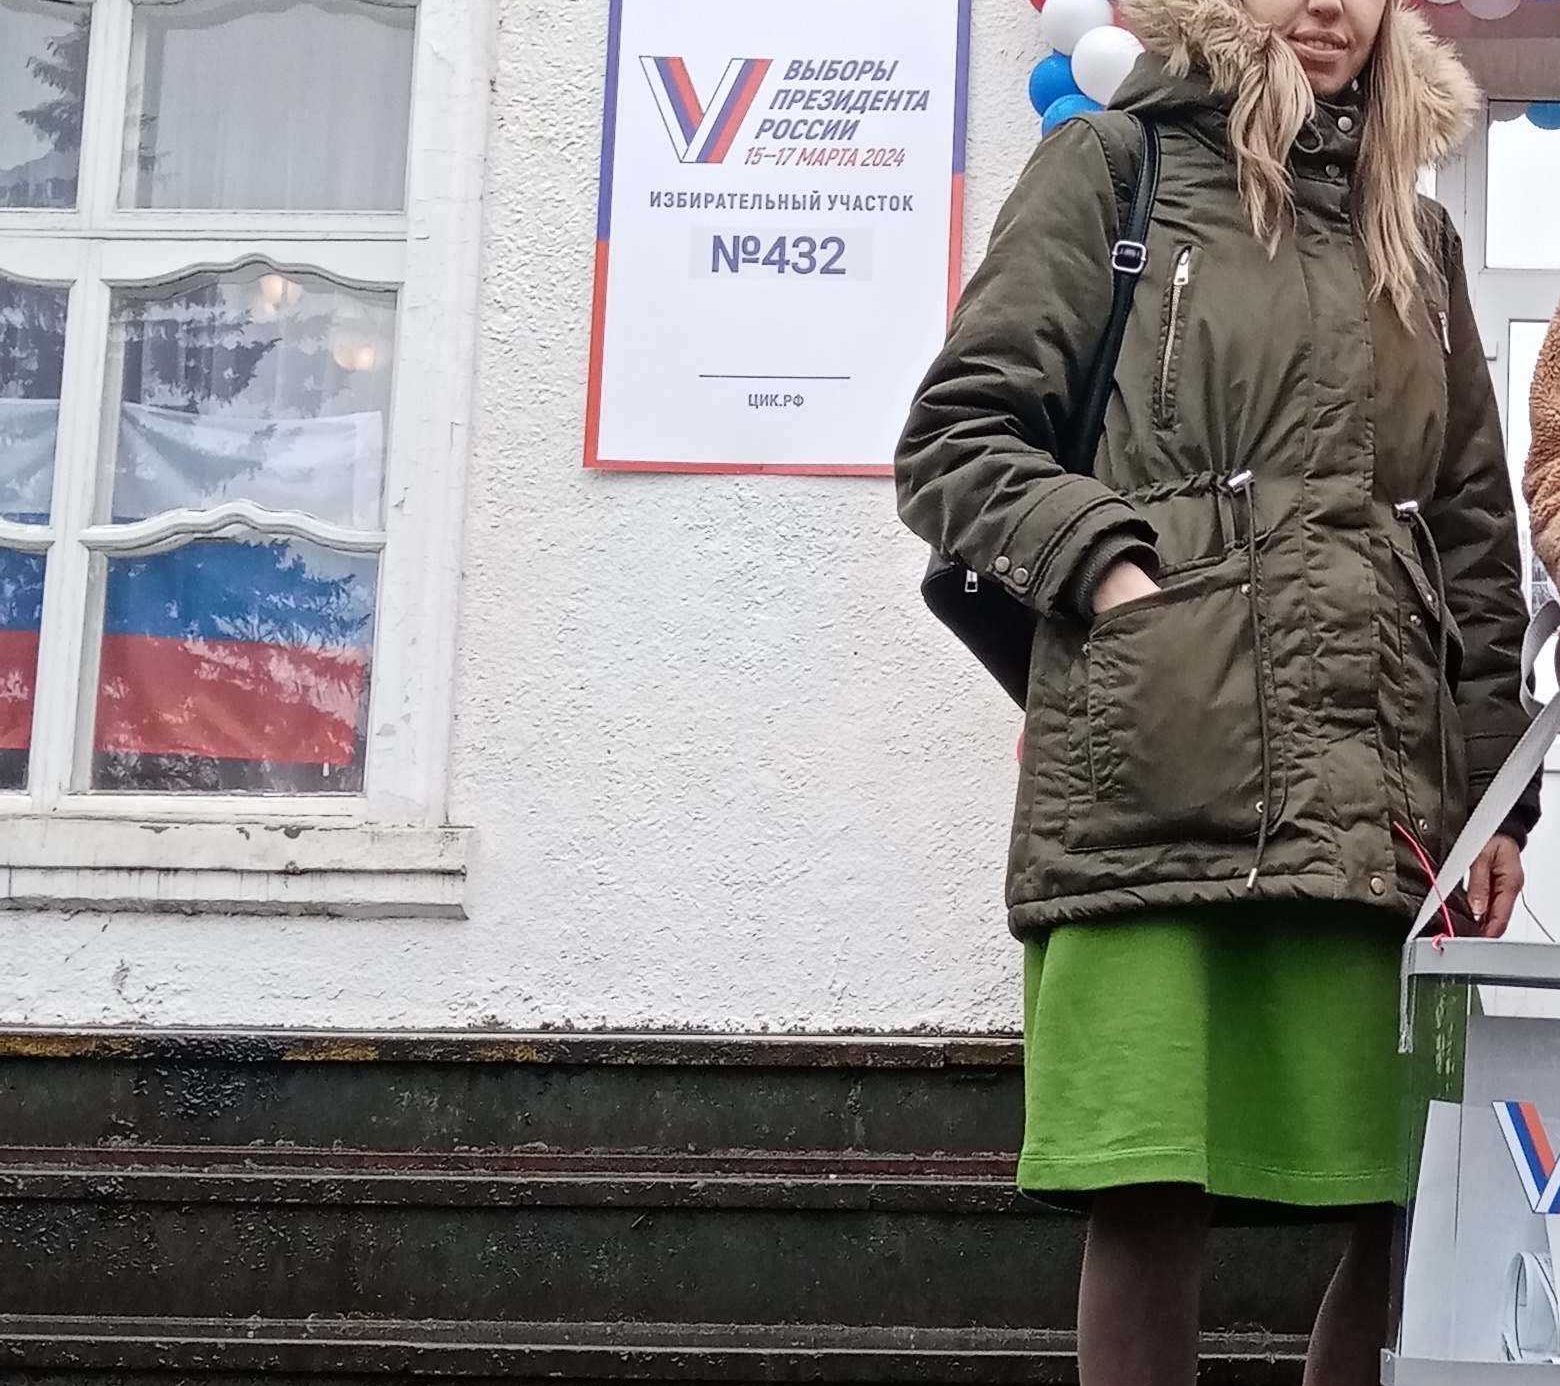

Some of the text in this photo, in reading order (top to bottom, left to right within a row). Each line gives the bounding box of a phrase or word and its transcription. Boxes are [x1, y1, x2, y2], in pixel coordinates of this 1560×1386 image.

[783, 59, 899, 82] ВЫБОРЫ
[768, 89, 931, 114] ПРЕЗИДЕНТА
[754, 118, 860, 141] РОССИИ
[744, 146, 906, 168] 15–17 МАРТА 2024
[649, 190, 914, 212] ИЗБИРАТЕЛЬНЫЙ УЧАСТОК
[711, 234, 847, 275] №432
[747, 392, 805, 411] ЦИК.РФ
